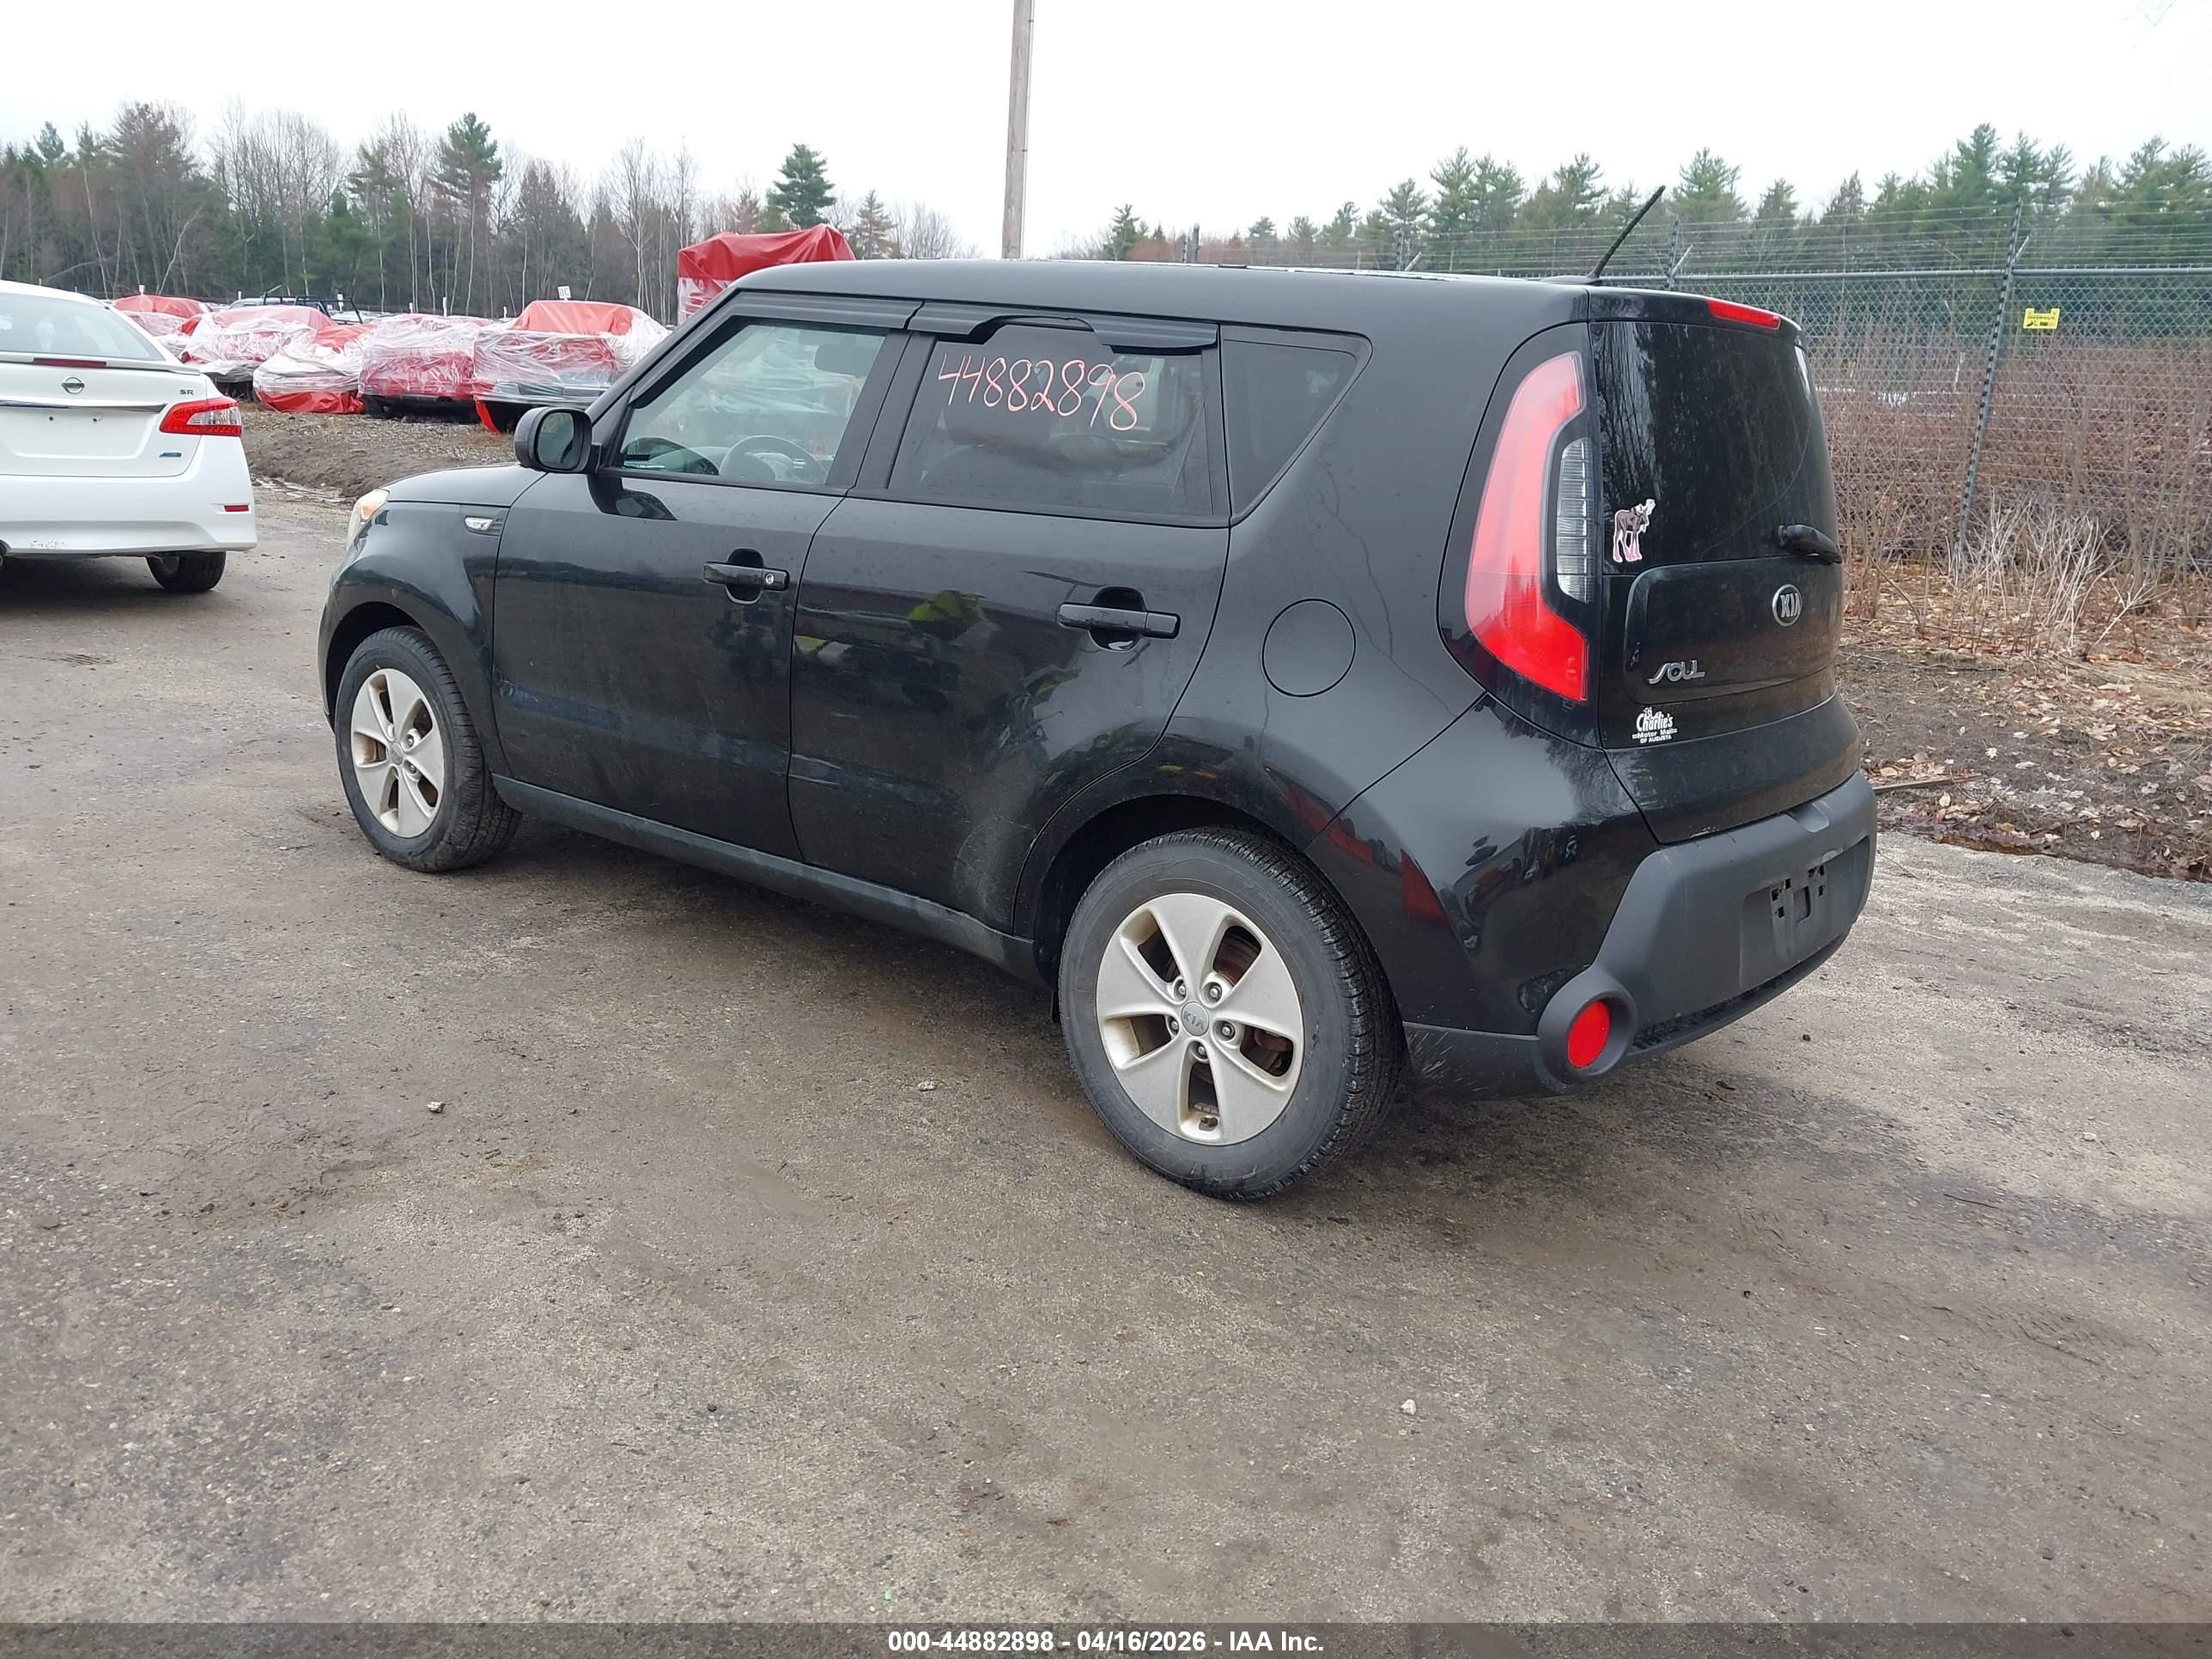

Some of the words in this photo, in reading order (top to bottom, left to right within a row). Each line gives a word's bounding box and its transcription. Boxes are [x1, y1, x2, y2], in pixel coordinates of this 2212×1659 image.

[939, 353, 1146, 430] 44882898
[1780, 592, 1801, 617] KIA
[1648, 659, 1705, 684] SOUL
[1636, 712, 1673, 732] Charlie's
[1183, 1011, 1204, 1030] KIA
